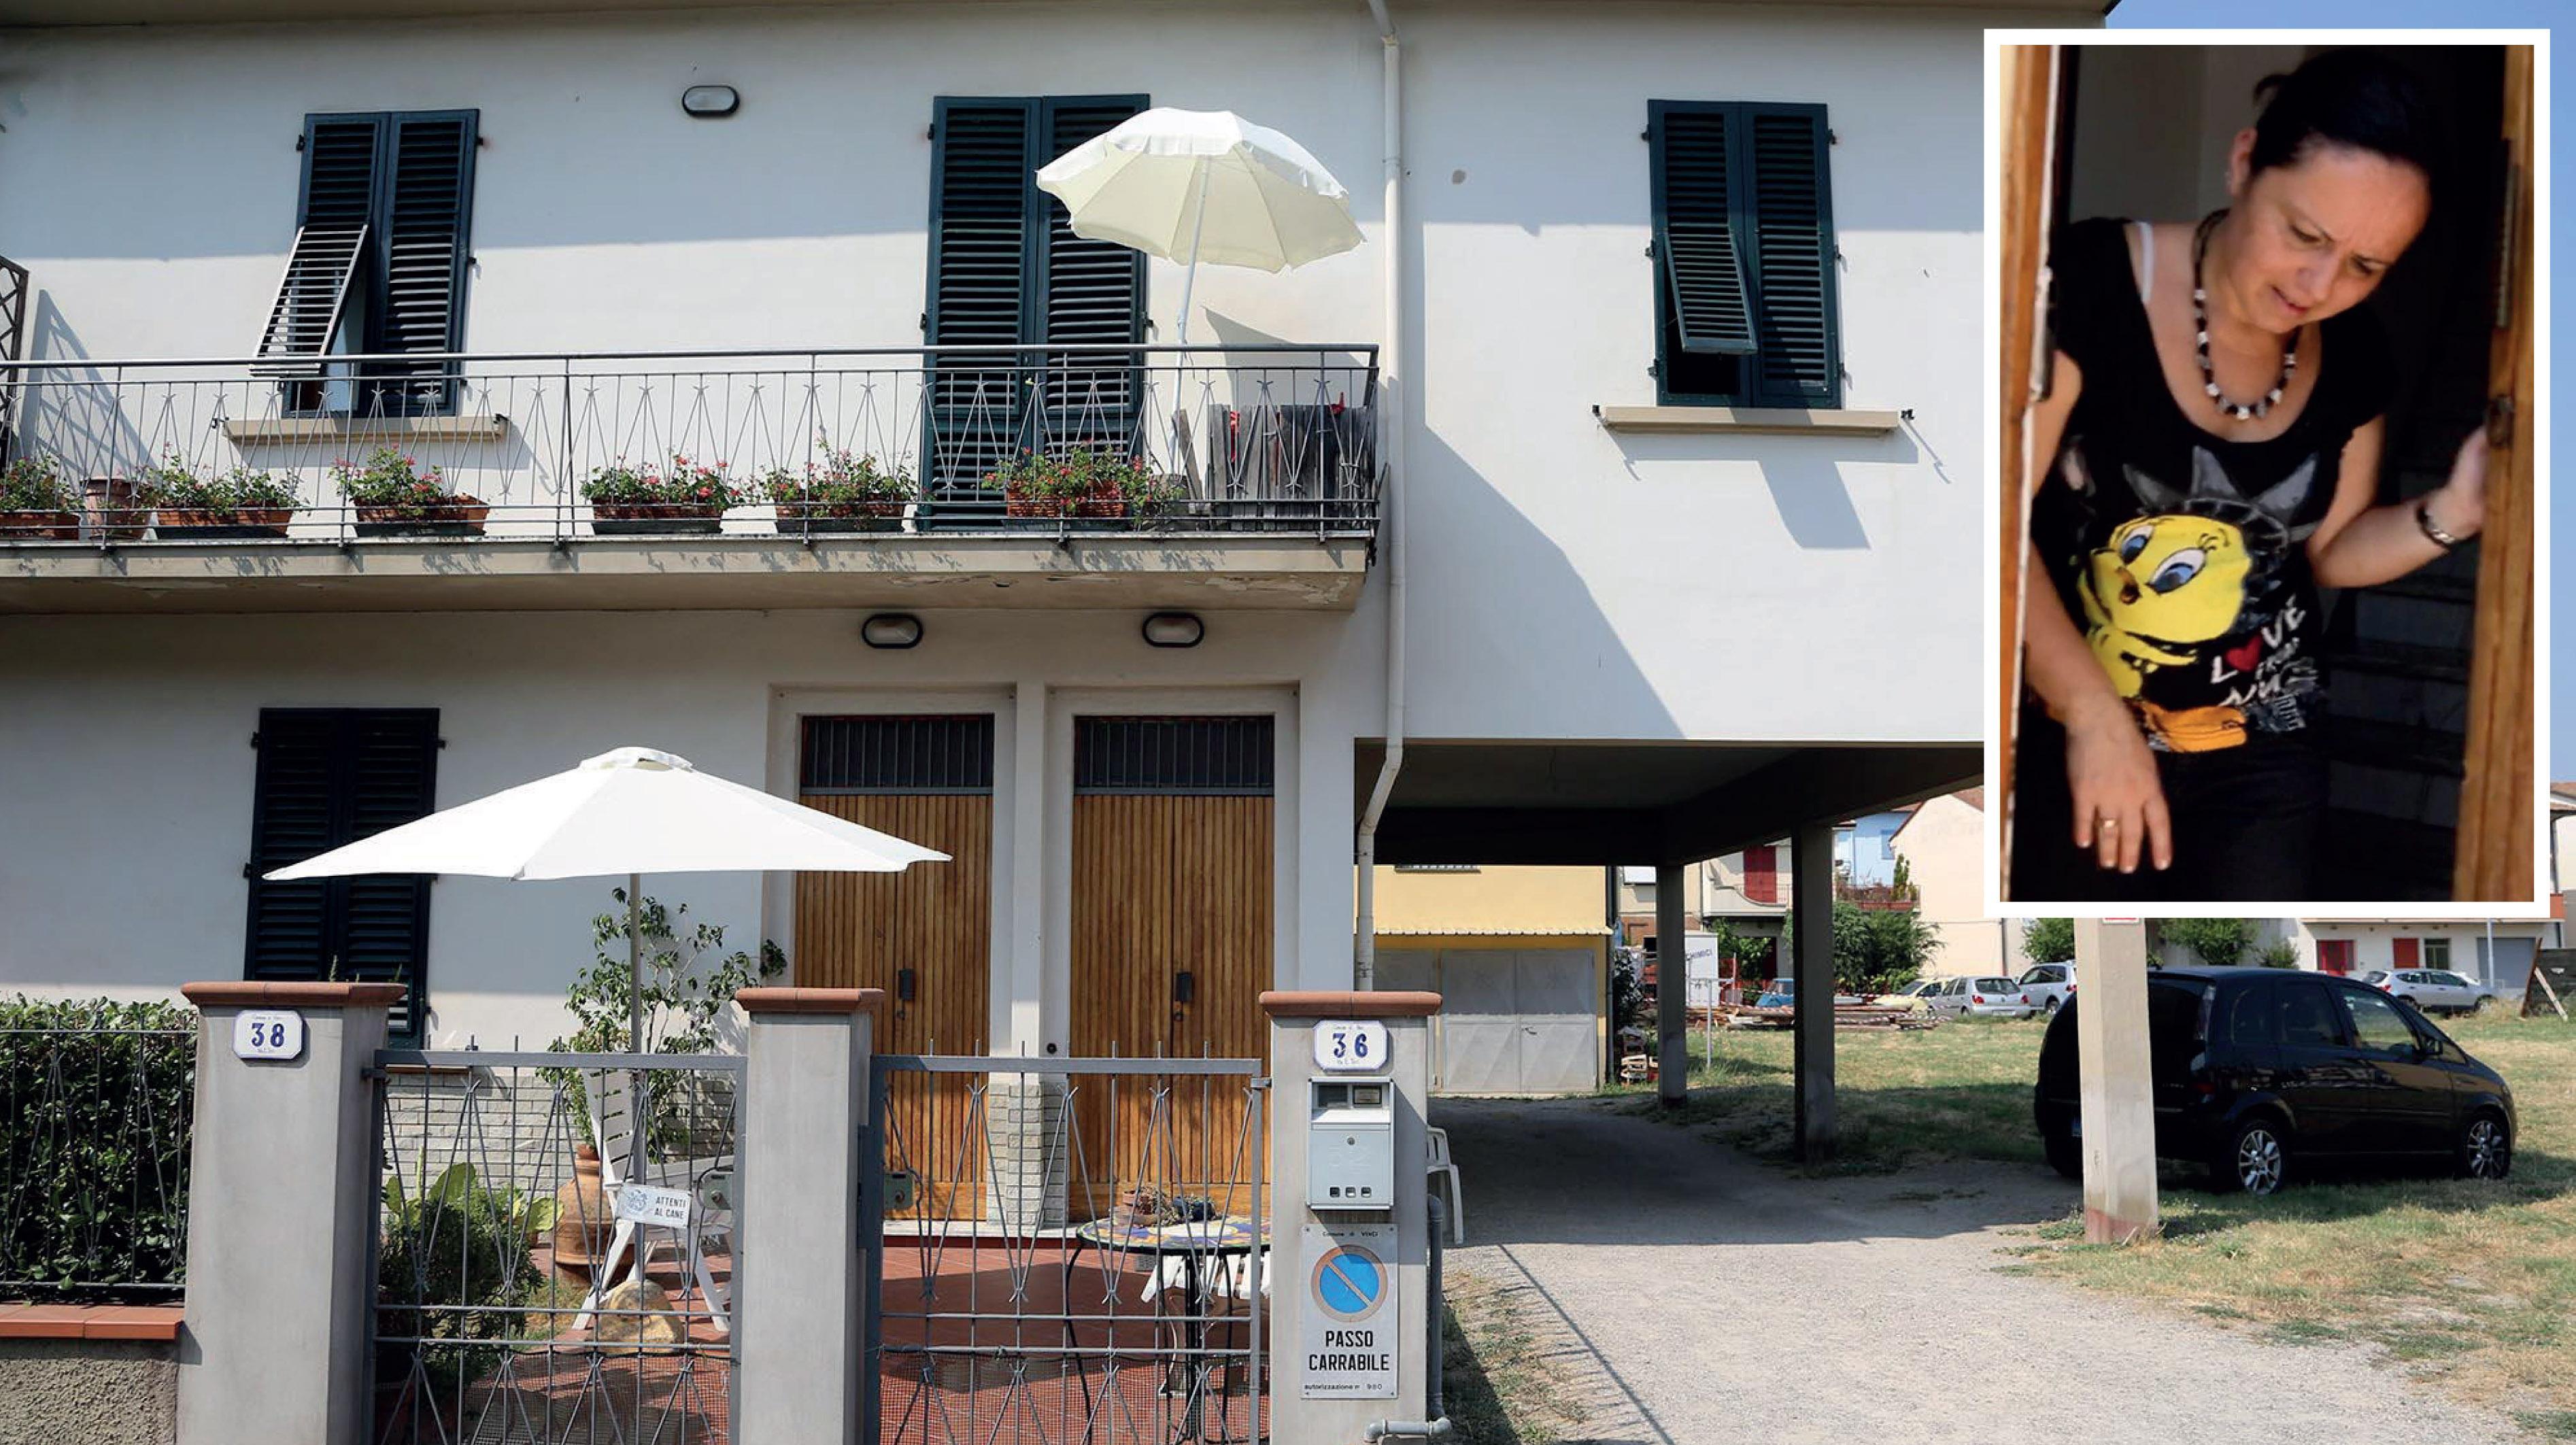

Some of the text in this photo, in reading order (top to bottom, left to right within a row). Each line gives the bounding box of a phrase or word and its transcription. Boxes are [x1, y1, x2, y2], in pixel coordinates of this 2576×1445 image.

[252, 1023, 285, 1047] 38
[1333, 1033, 1368, 1058] 36
[655, 1196, 686, 1208] ATTENTI
[654, 1208, 684, 1219] AL CANE
[1325, 1330, 1374, 1348] PASSO
[1308, 1353, 1390, 1372] CARRABILE
